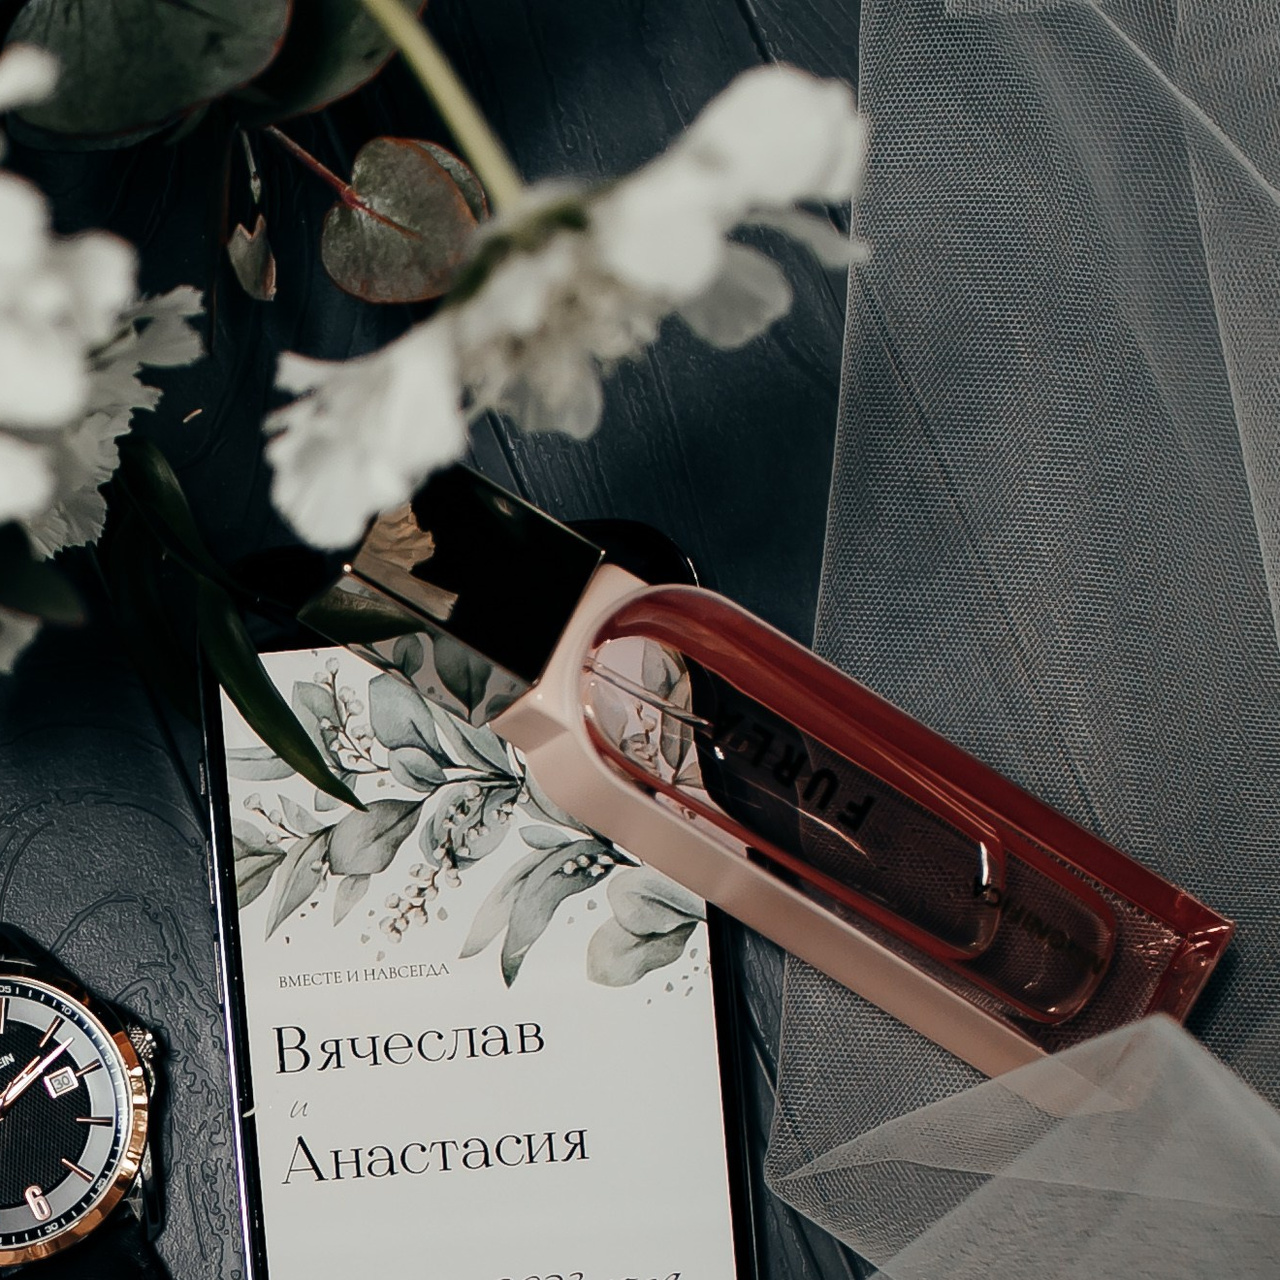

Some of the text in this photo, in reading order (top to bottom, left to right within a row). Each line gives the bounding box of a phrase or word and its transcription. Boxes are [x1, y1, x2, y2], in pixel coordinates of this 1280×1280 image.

[278, 962, 450, 989] ВМЕСТЕ И НАВСЕГДА
[60, 1005, 72, 1015] 10
[271, 1022, 545, 1075] Вячеслав
[53, 1075, 71, 1089] 30
[280, 1128, 590, 1185] Анастасия
[24, 1185, 53, 1222] 6
[44, 1222, 59, 1233] 30
